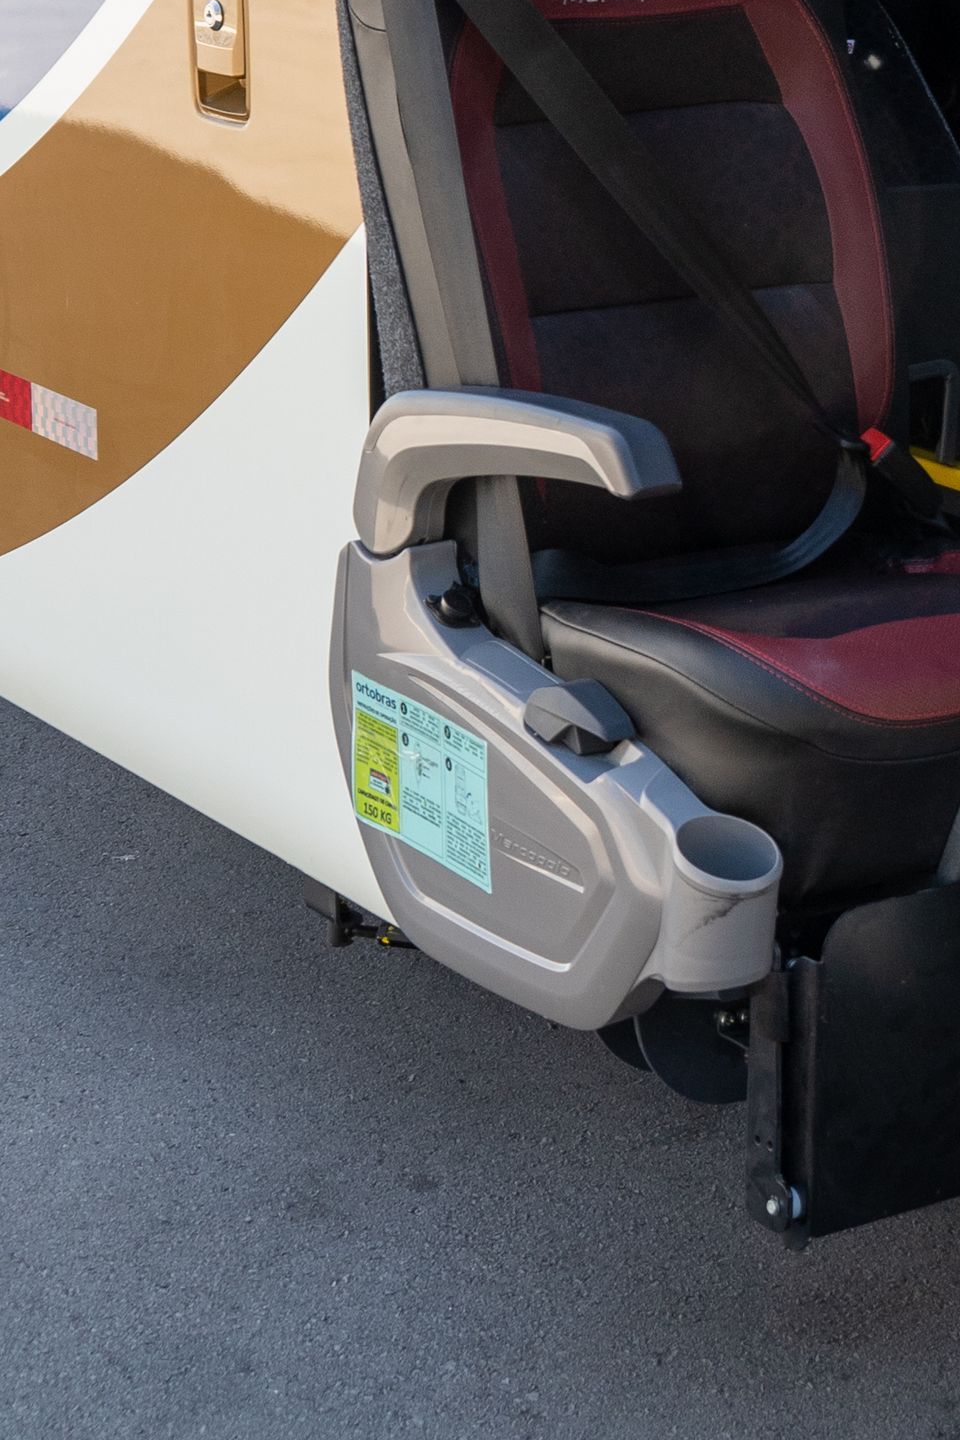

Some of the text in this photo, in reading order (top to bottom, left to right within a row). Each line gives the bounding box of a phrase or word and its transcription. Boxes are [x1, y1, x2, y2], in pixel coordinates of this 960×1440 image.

[356, 682, 396, 709] ortobras
[364, 802, 378, 818] 150
[380, 809, 392, 824] KG
